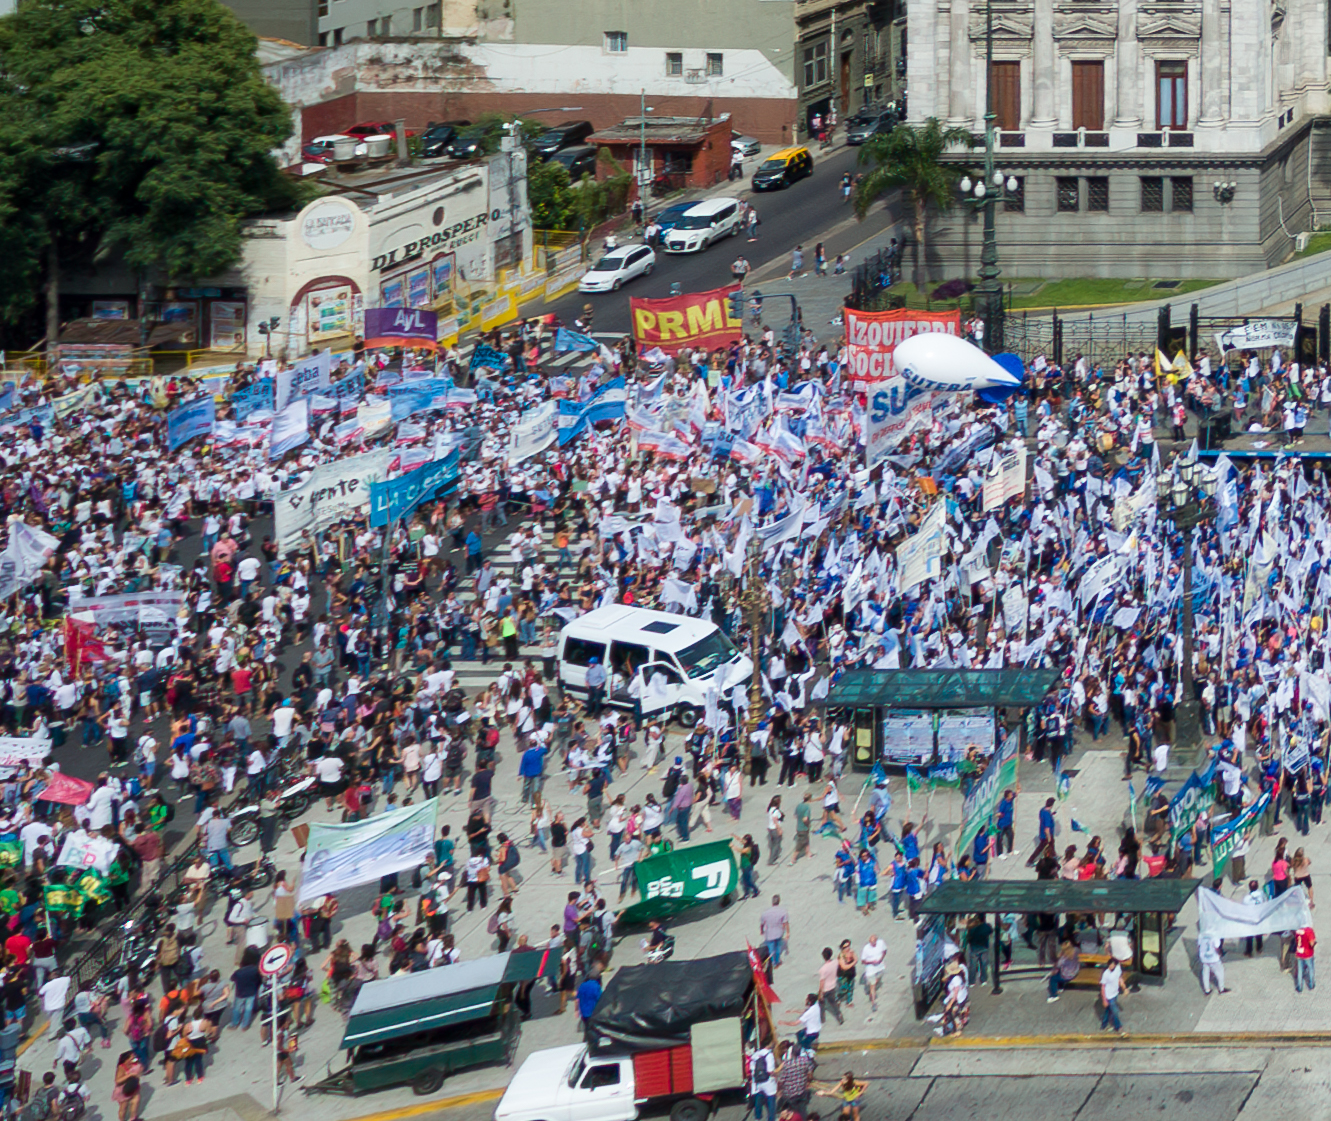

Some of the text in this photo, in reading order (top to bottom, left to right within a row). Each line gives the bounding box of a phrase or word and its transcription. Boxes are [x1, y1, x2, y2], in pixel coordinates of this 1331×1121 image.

[370, 209, 501, 272] DI PROSPERO
[901, 366, 973, 392] SUTEBA
